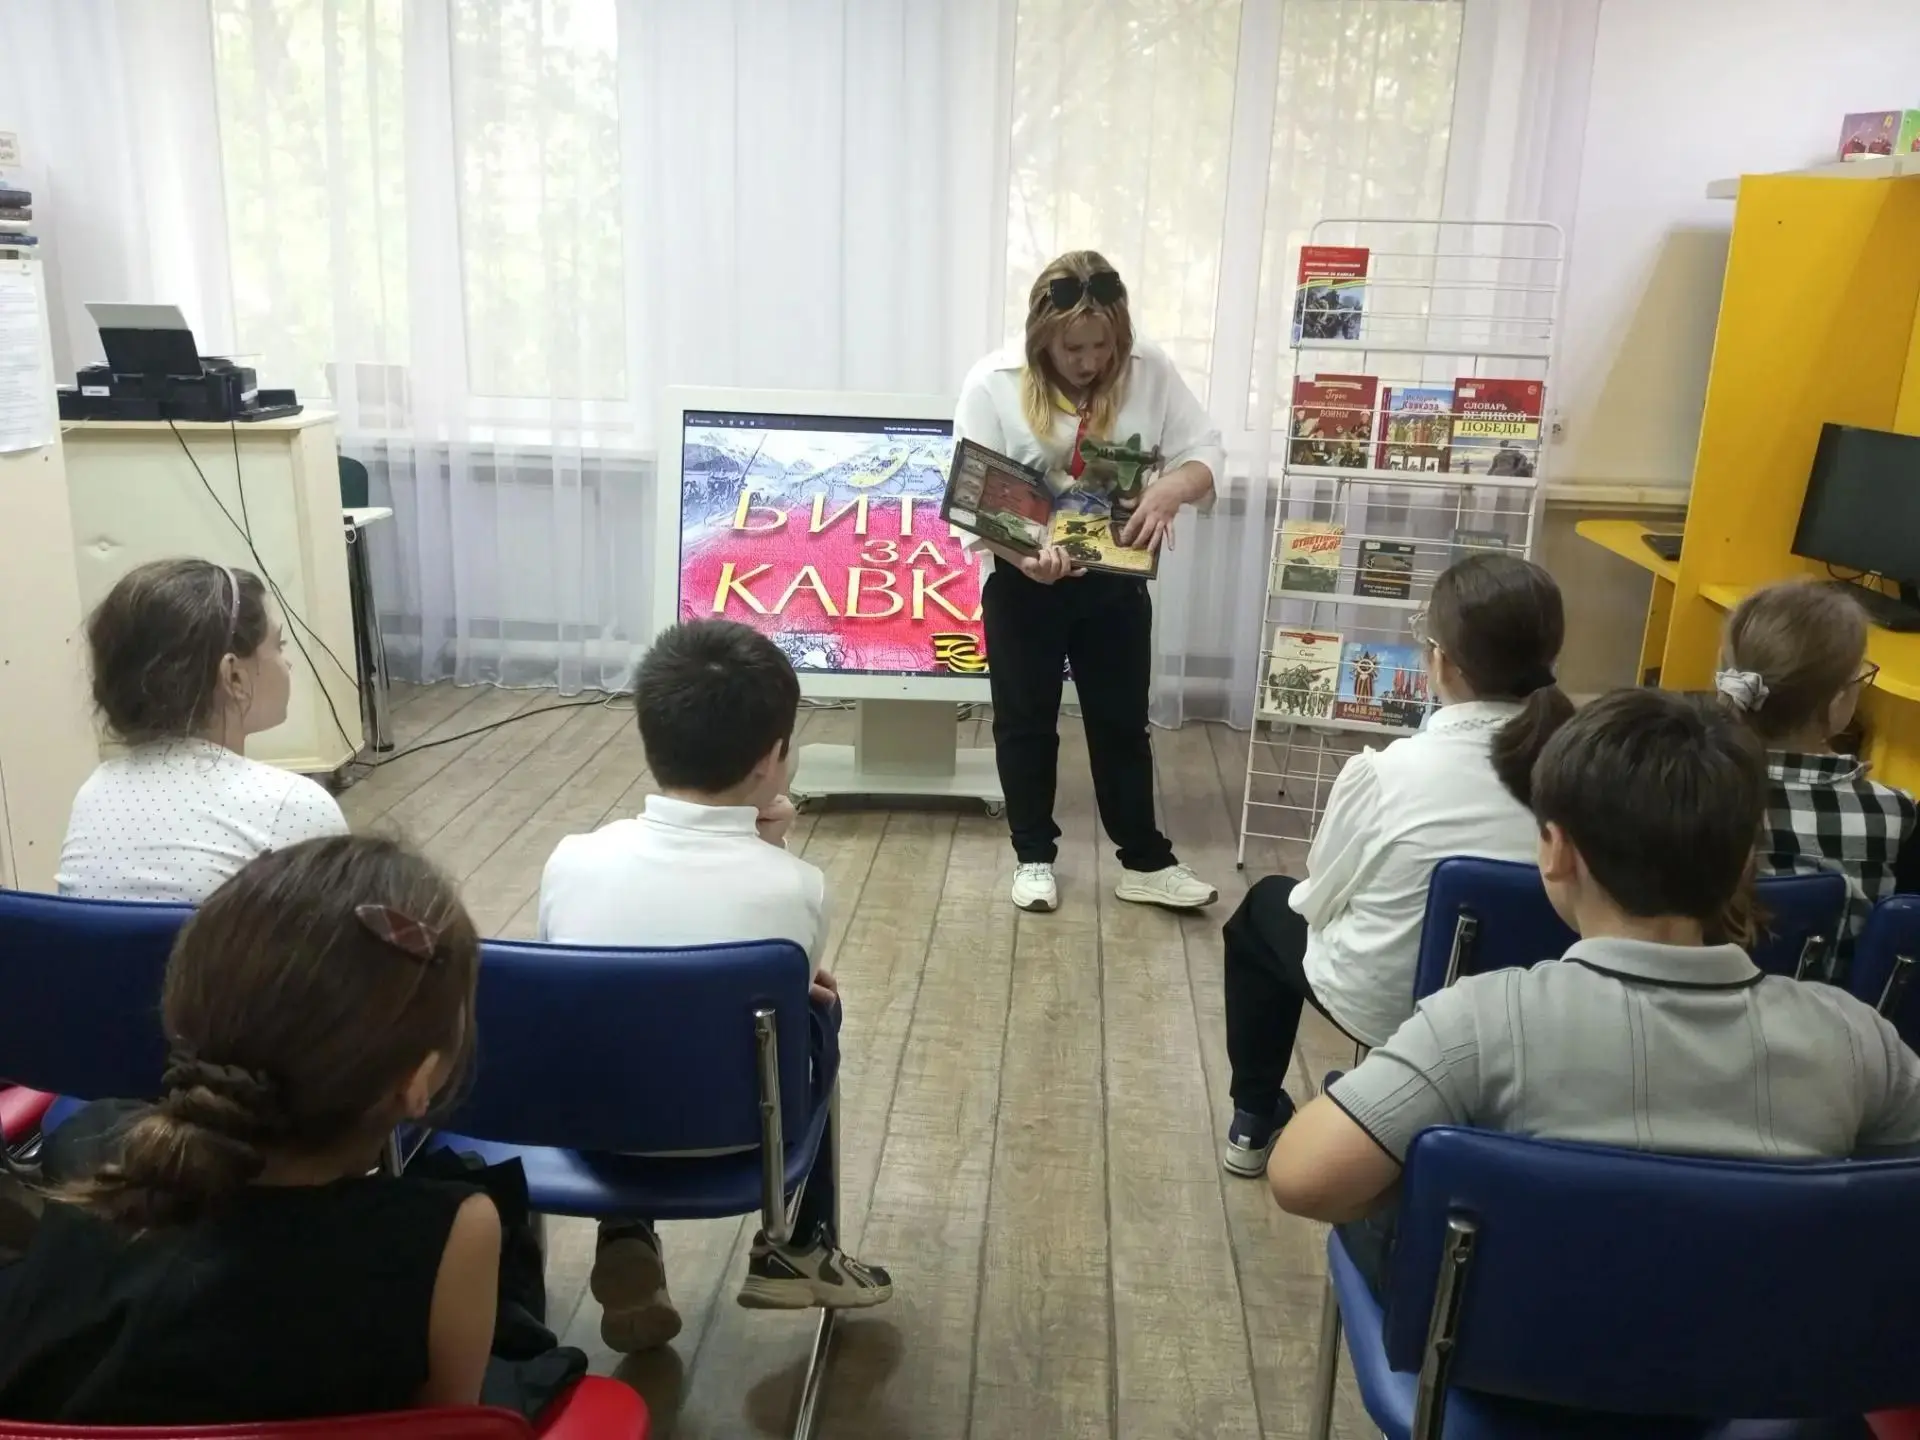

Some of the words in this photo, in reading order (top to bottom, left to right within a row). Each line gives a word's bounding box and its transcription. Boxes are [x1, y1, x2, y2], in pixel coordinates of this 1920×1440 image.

[1462, 410, 1528, 422] ВЕЛИКОЙ
[1463, 402, 1508, 411] СЛОВАРЬ
[1461, 421, 1526, 436] ПОБЕДЫ
[730, 489, 961, 538] БИТ
[861, 539, 947, 565] ЗА
[711, 562, 983, 621] КАВК
